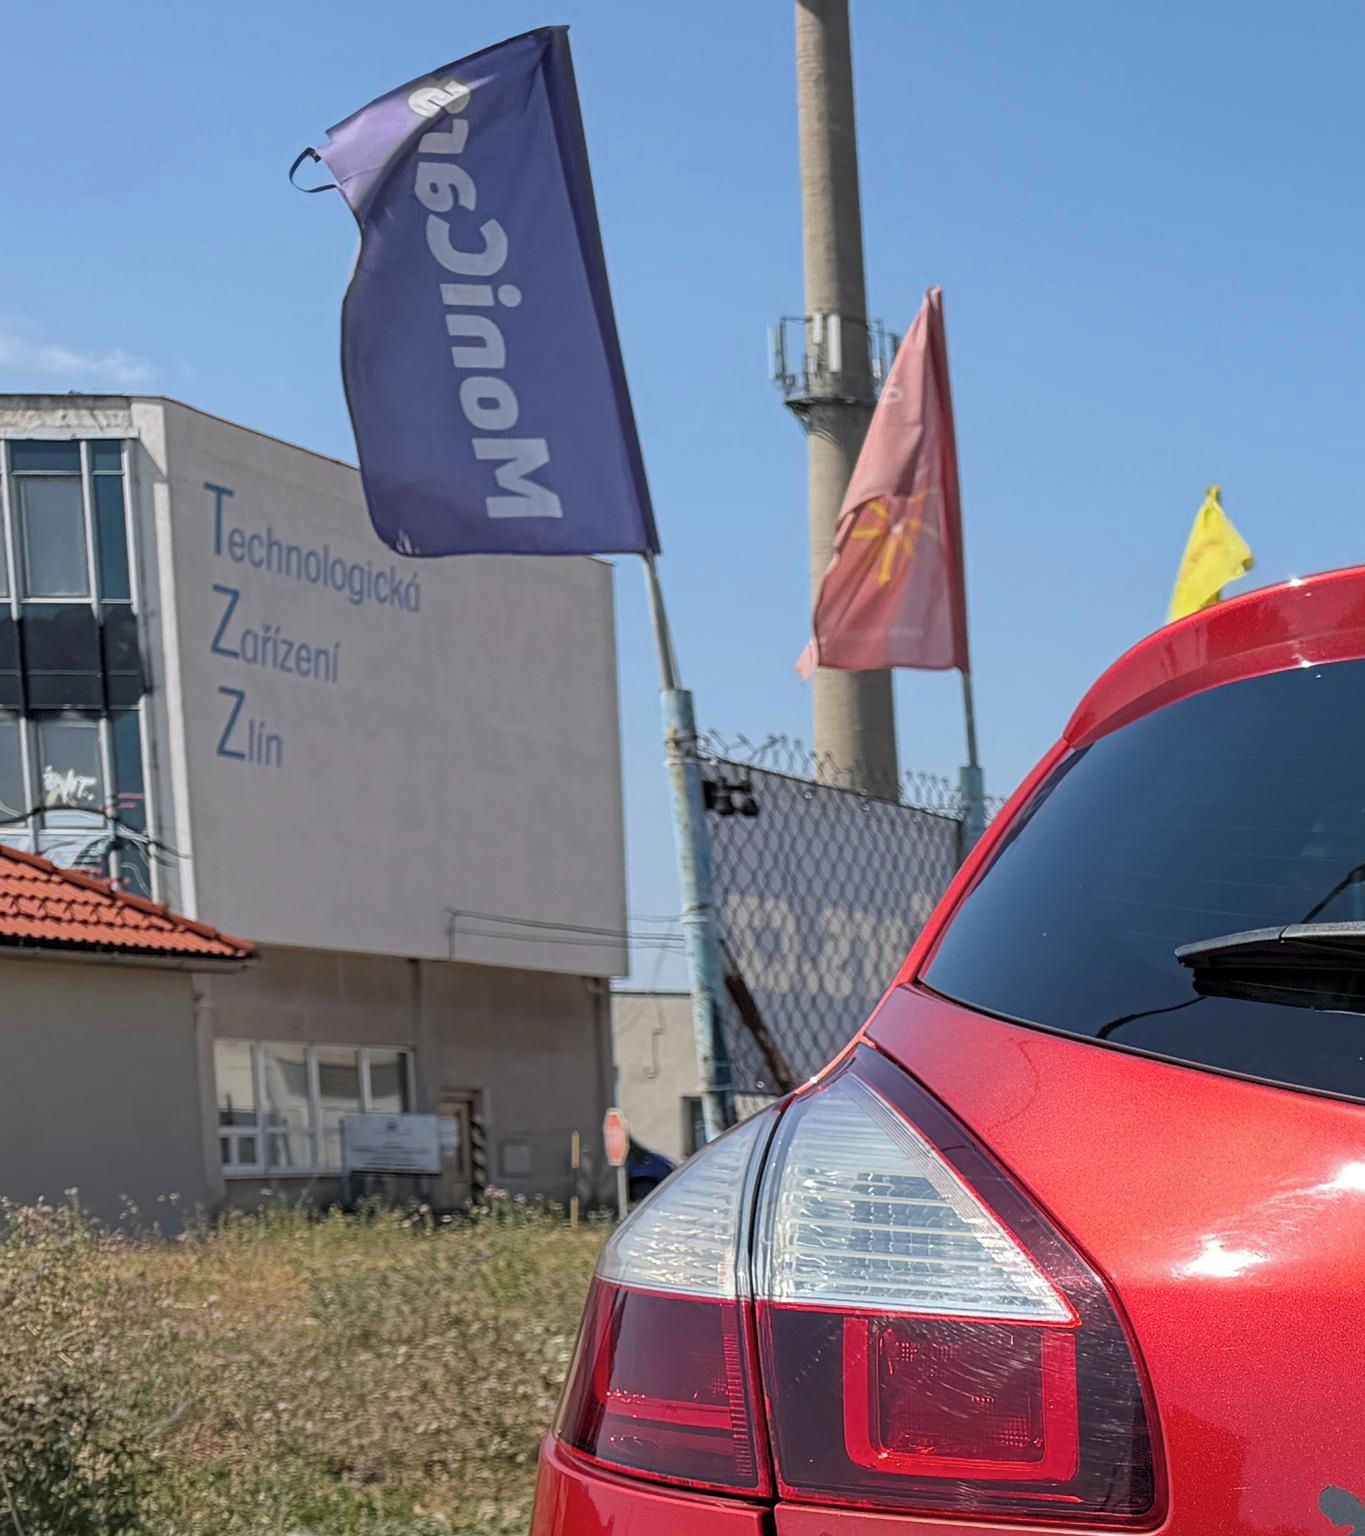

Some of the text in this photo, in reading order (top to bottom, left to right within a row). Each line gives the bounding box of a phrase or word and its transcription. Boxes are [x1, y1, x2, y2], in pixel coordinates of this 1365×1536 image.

[203, 482, 421, 612] Technologická
[210, 584, 341, 684] Zařízení
[216, 685, 284, 768] Zlín
